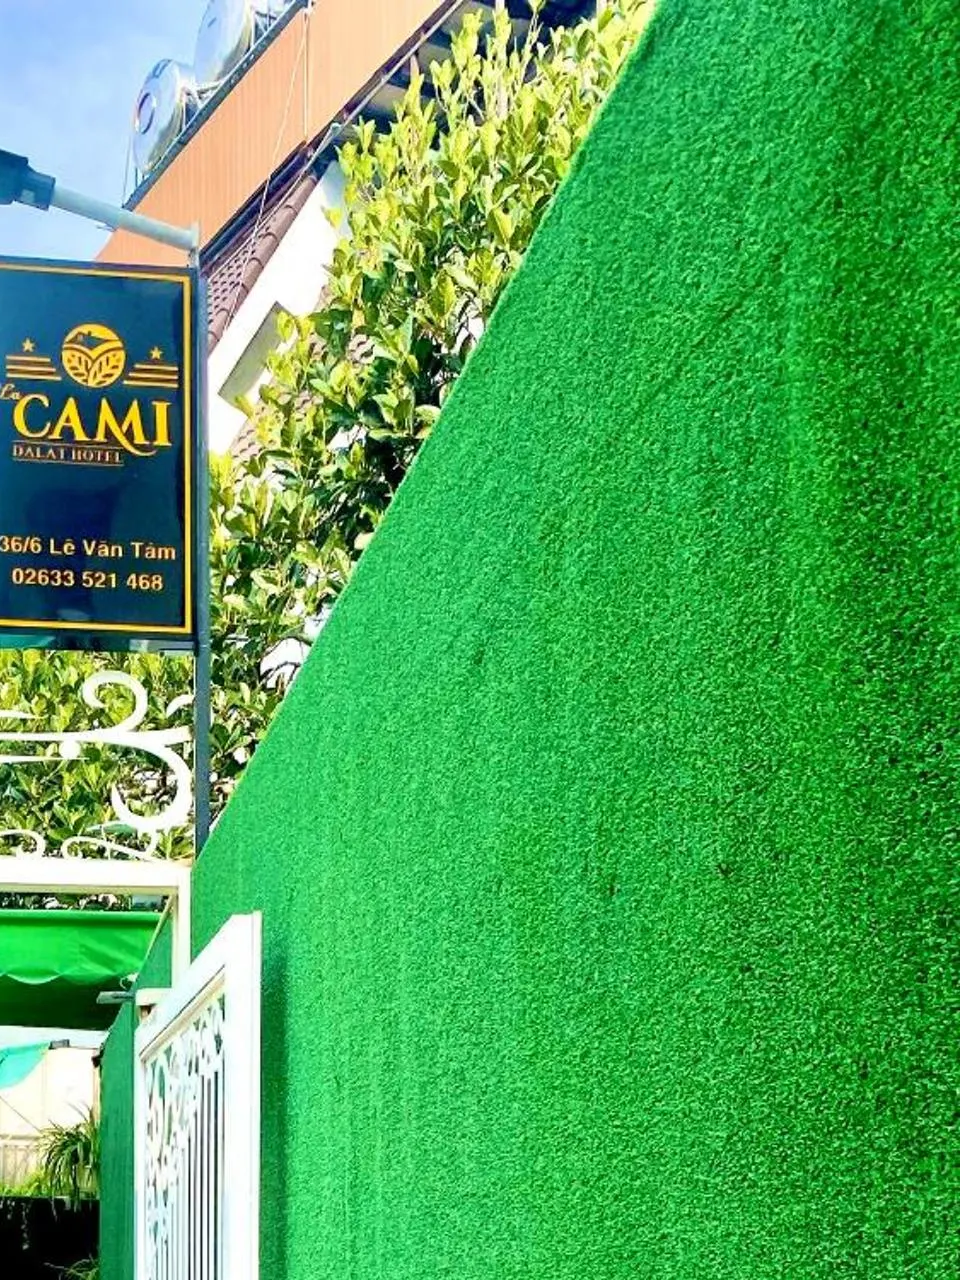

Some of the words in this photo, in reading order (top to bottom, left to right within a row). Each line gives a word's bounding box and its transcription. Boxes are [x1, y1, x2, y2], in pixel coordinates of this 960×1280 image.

[12, 393, 172, 456] CAMI
[12, 444, 66, 461] DALAT
[71, 448, 124, 463] HOTEL
[49, 537, 76, 556] Lê
[11, 567, 75, 587] 02633
[82, 571, 117, 589] 521
[126, 572, 164, 591] 468
